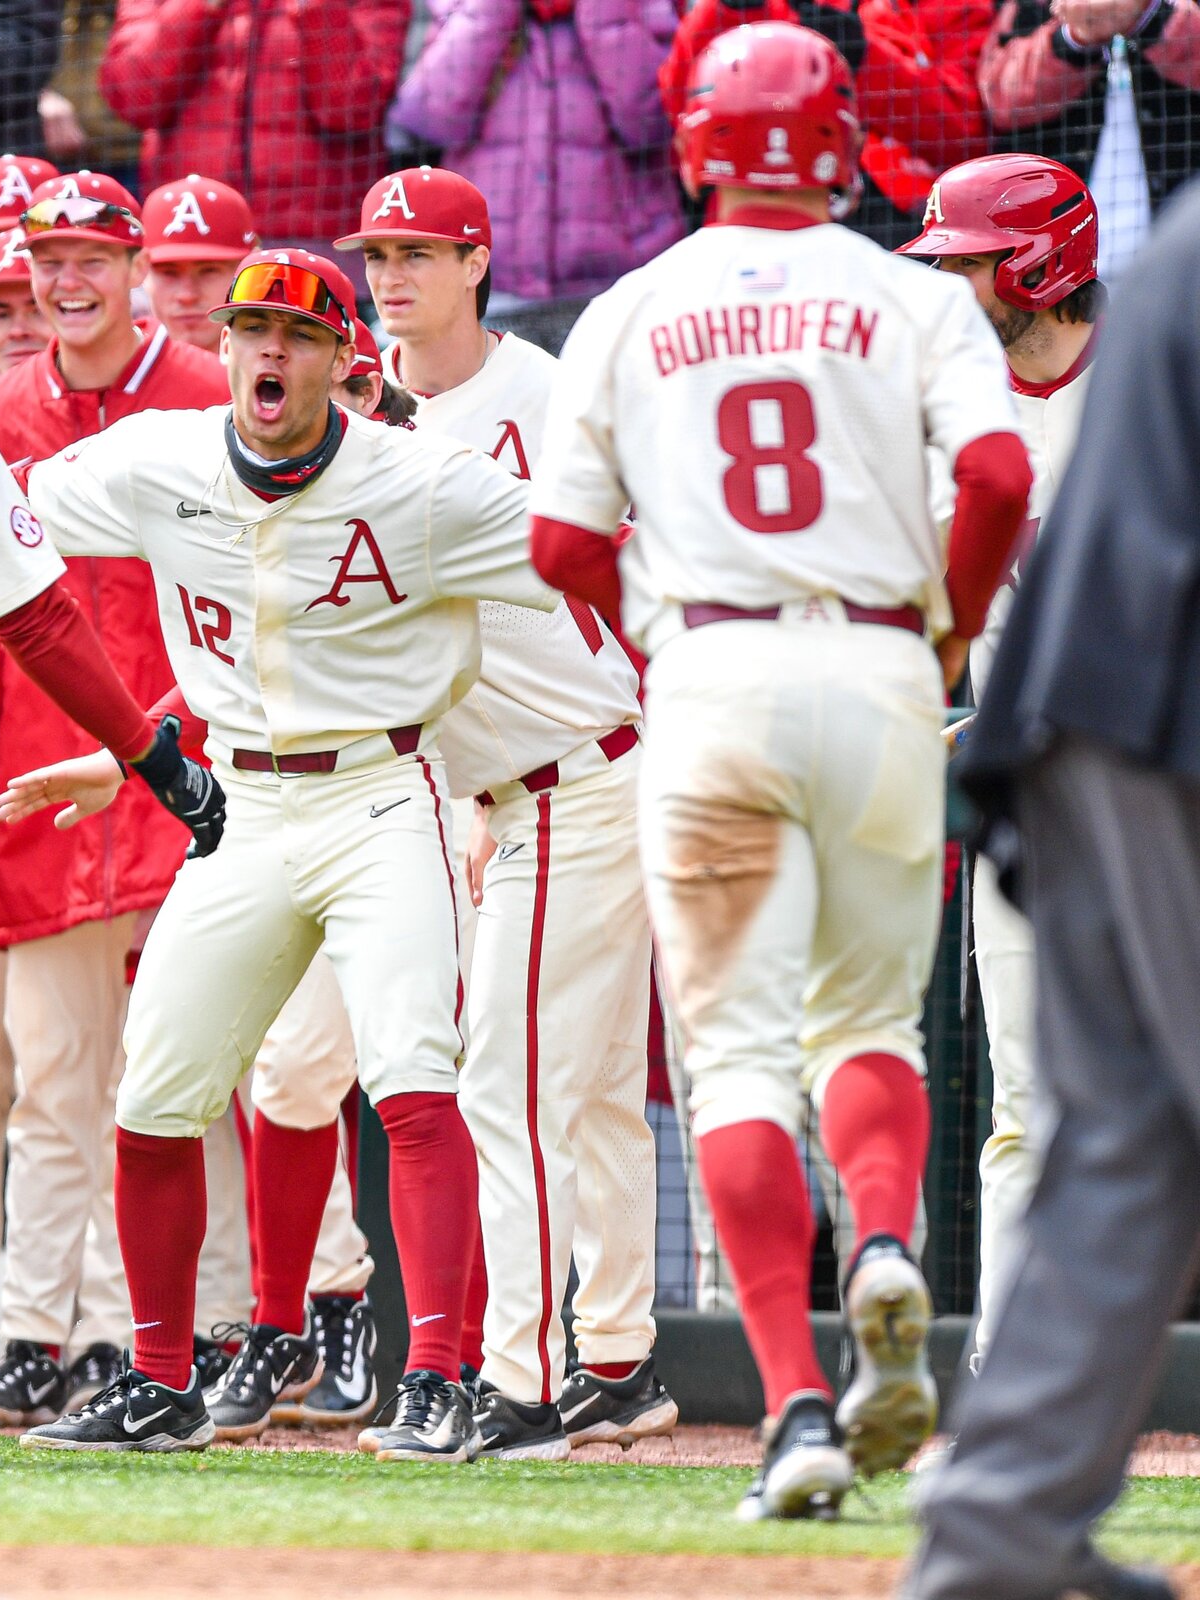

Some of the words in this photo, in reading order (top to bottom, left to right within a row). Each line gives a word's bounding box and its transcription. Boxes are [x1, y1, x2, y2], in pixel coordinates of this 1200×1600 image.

[163, 192, 211, 237] A
[372, 177, 415, 222] A
[922, 183, 945, 226] A
[650, 299, 879, 378] BOHROFEN
[717, 380, 825, 533] 8
[304, 518, 408, 612] A
[175, 582, 235, 668] 12
